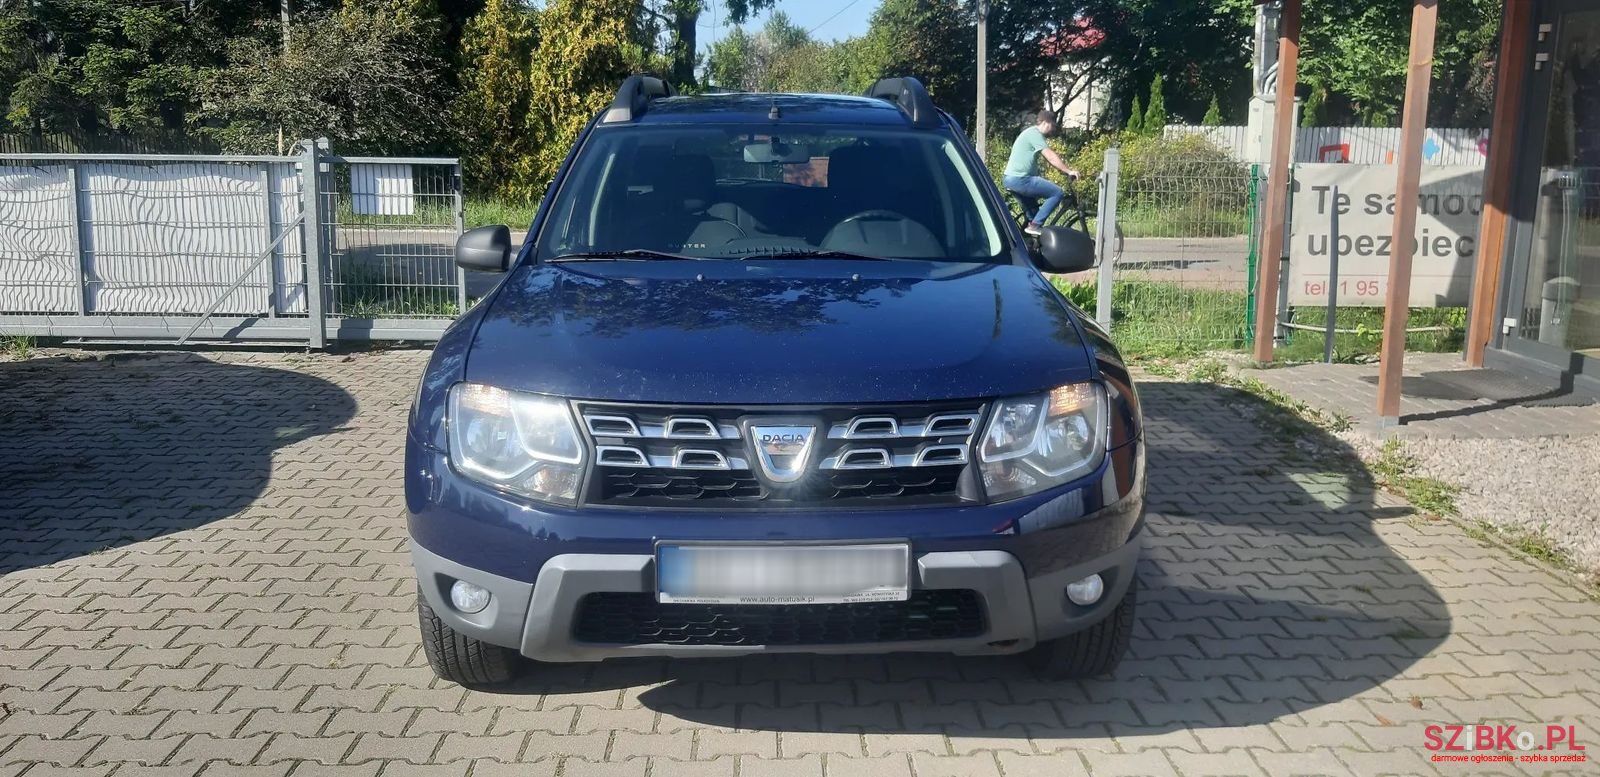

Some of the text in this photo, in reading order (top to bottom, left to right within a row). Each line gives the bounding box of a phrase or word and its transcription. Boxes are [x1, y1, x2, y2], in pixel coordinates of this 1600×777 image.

[1311, 185, 1351, 215] Te
[1356, 280, 1379, 296] 95
[762, 434, 804, 442] DACIA
